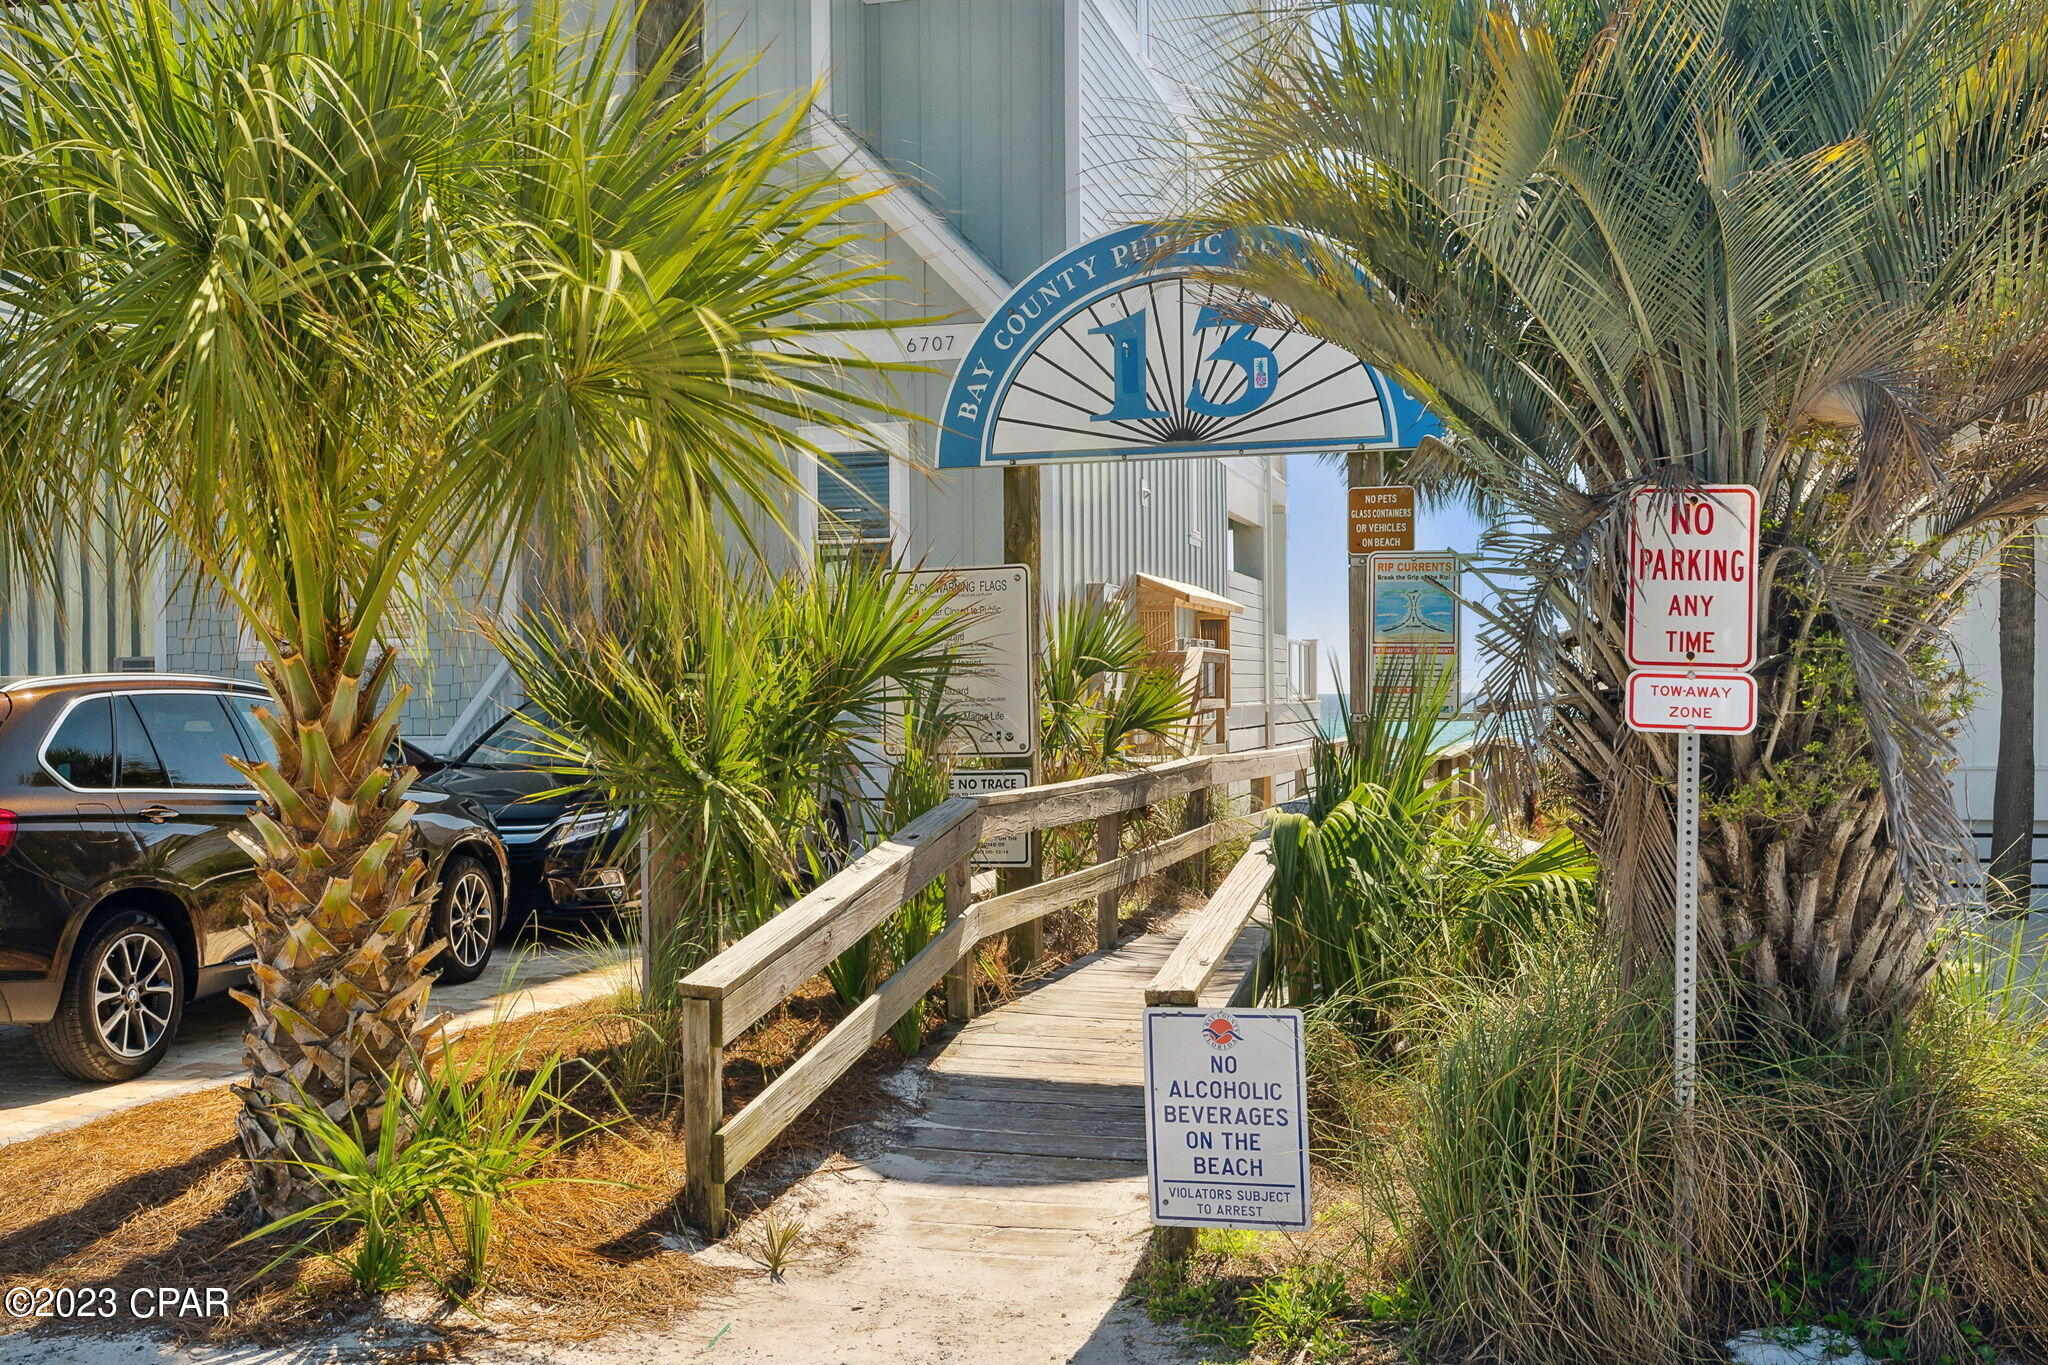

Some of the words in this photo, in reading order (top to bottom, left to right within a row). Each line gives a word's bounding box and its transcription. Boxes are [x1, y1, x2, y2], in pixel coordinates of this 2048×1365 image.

[906, 335, 955, 352] 6707
[958, 357, 995, 422] BAY
[993, 255, 1098, 350] COUNTY
[1088, 298, 1279, 422] 13
[1365, 495, 1376, 504] NO
[1377, 494, 1398, 504] PETS
[1351, 509, 1372, 519] GLASS
[1372, 508, 1412, 518] CONTAINERS
[1671, 503, 1714, 535] NO
[1356, 523, 1367, 533] OR
[1368, 523, 1407, 532] VEHICLES
[1362, 538, 1373, 547] ON
[1374, 537, 1401, 547] BEACH
[1377, 562, 1394, 572] RIP
[1396, 561, 1452, 572] CURRENTS
[1639, 549, 1744, 582] PARKING
[979, 579, 1008, 592] FLAGS
[1667, 595, 1714, 616] ANY
[1666, 631, 1715, 653] TIME
[1651, 685, 1732, 698] TOW-AWAY
[990, 711, 1005, 720] Life
[1669, 707, 1712, 719] ZONE
[958, 779, 978, 790] NO
[981, 778, 1017, 789] TRACE
[1210, 1056, 1237, 1073] NO
[1169, 1081, 1282, 1100] ALCOHOLIC
[1164, 1105, 1289, 1126] BEVERAGES
[1186, 1131, 1212, 1149] ON
[1222, 1132, 1261, 1151] THE
[1194, 1157, 1263, 1176] BEACH
[1169, 1187, 1232, 1200] VIOLATORS
[1237, 1191, 1291, 1203] SUBJECT
[1197, 1203, 1212, 1214] TO
[1217, 1204, 1263, 1216] ARREST
